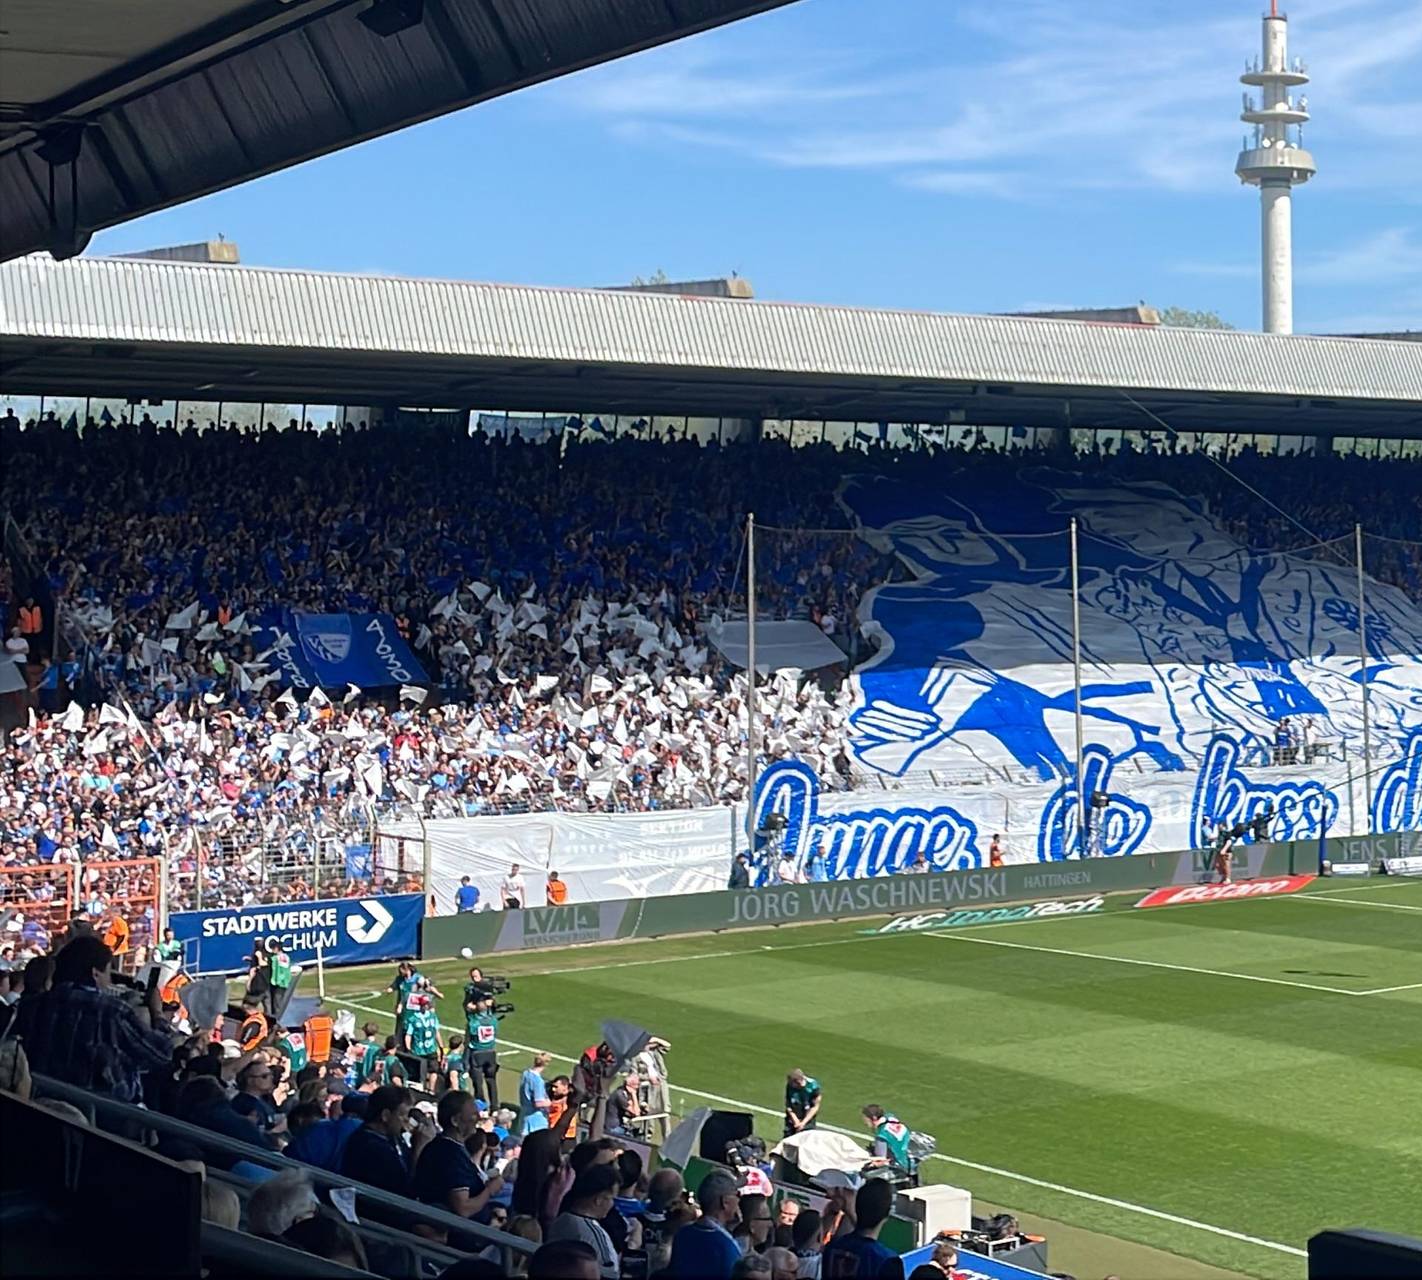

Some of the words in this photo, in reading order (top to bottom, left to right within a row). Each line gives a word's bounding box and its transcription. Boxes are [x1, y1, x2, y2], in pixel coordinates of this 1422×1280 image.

[729, 889, 800, 923] JÖRG
[810, 873, 1007, 914] WASCHNEWSKI
[1023, 871, 1092, 889] HATTINGEN
[202, 908, 337, 937] STADTWERKE
[254, 929, 337, 953] OCHUM
